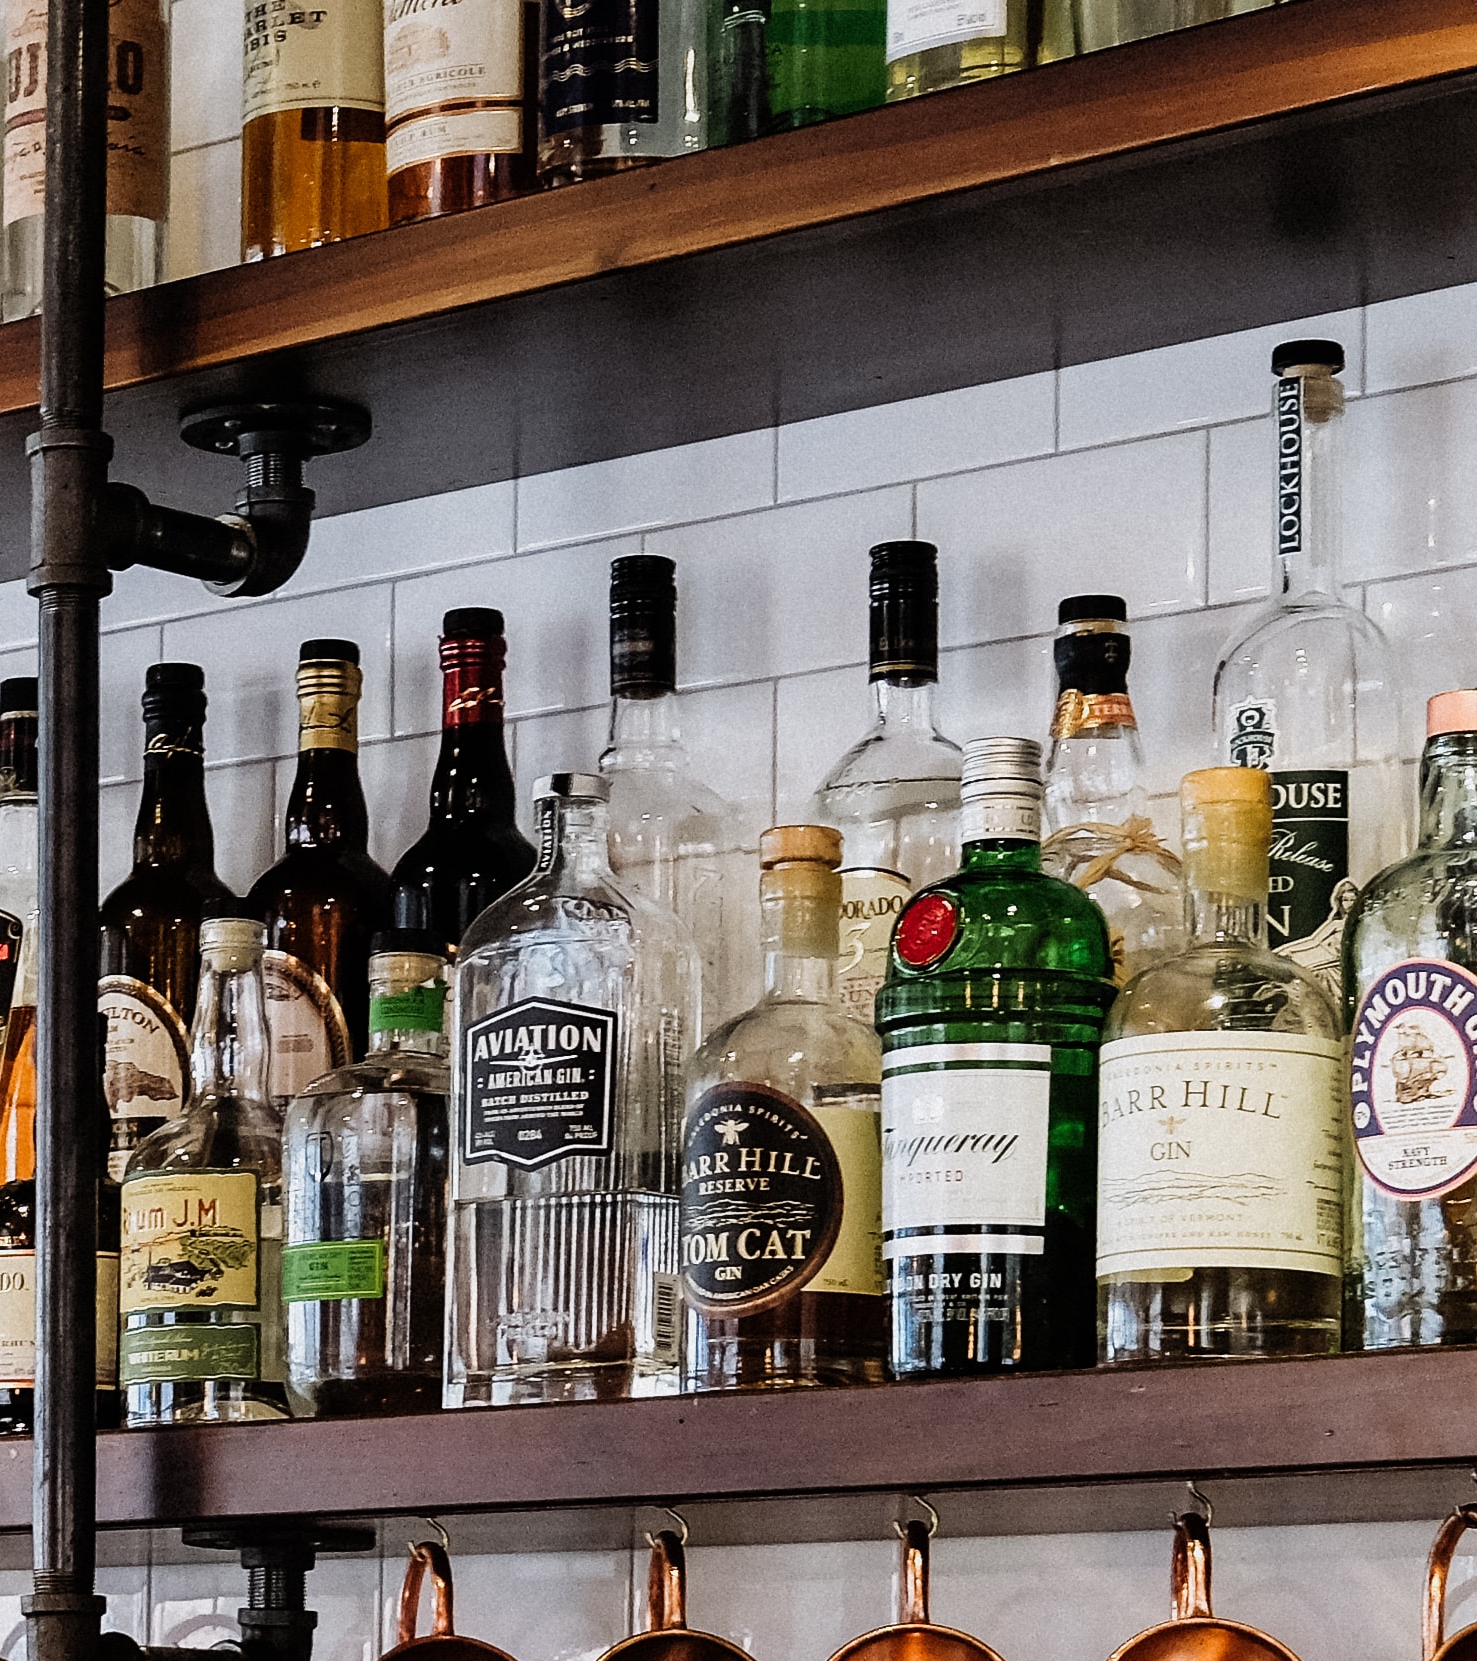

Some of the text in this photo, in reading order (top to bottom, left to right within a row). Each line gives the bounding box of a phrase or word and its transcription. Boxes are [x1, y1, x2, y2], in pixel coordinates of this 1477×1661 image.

[248, 29, 288, 52] BIS
[1279, 378, 1301, 552] LOCKHOUSE
[1351, 971, 1476, 1093] PLYMOUTH
[473, 1024, 603, 1064] AVIATION
[486, 1068, 553, 1090] AMERICAN
[480, 1091, 590, 1108] BATCH DISTILLED
[1102, 1079, 1282, 1130] BARR HILL
[884, 1127, 1020, 1168] anqueray
[1149, 1140, 1193, 1162] GIN
[736, 1146, 823, 1181] HILL
[698, 1176, 772, 1196] RESERVE
[899, 1170, 964, 1184] MPORTED
[682, 1227, 813, 1267] TOM CAT
[713, 1265, 744, 1282] GIN
[927, 1271, 1003, 1289] DRY GIN
